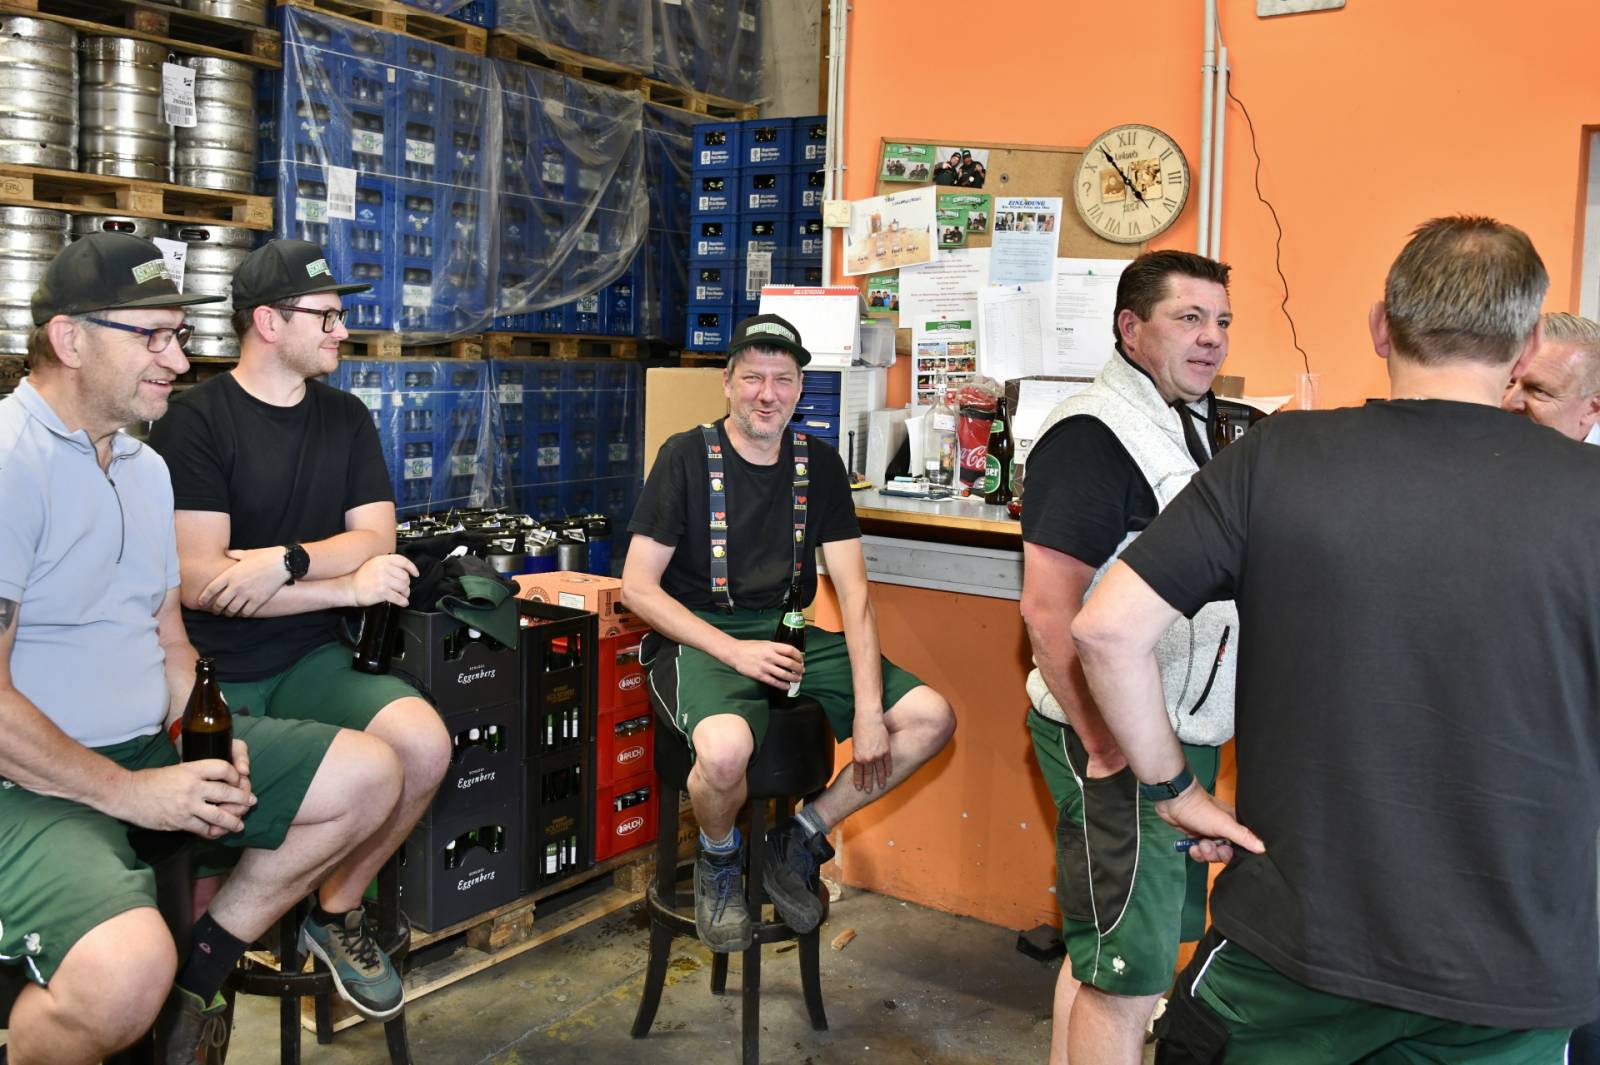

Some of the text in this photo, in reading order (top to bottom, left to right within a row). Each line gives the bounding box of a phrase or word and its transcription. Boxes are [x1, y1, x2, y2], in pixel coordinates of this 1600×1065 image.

[1117, 131, 1137, 148] XII
[1160, 147, 1174, 161] II
[1084, 162, 1098, 174] X
[1167, 170, 1182, 184] III
[1162, 197, 1178, 213] IV
[1128, 221, 1142, 236] VI
[1150, 215, 1161, 228] V
[457, 669, 496, 685] Eggenberg
[457, 771, 496, 789] Eggenberg
[457, 871, 496, 891] Eggenberg
